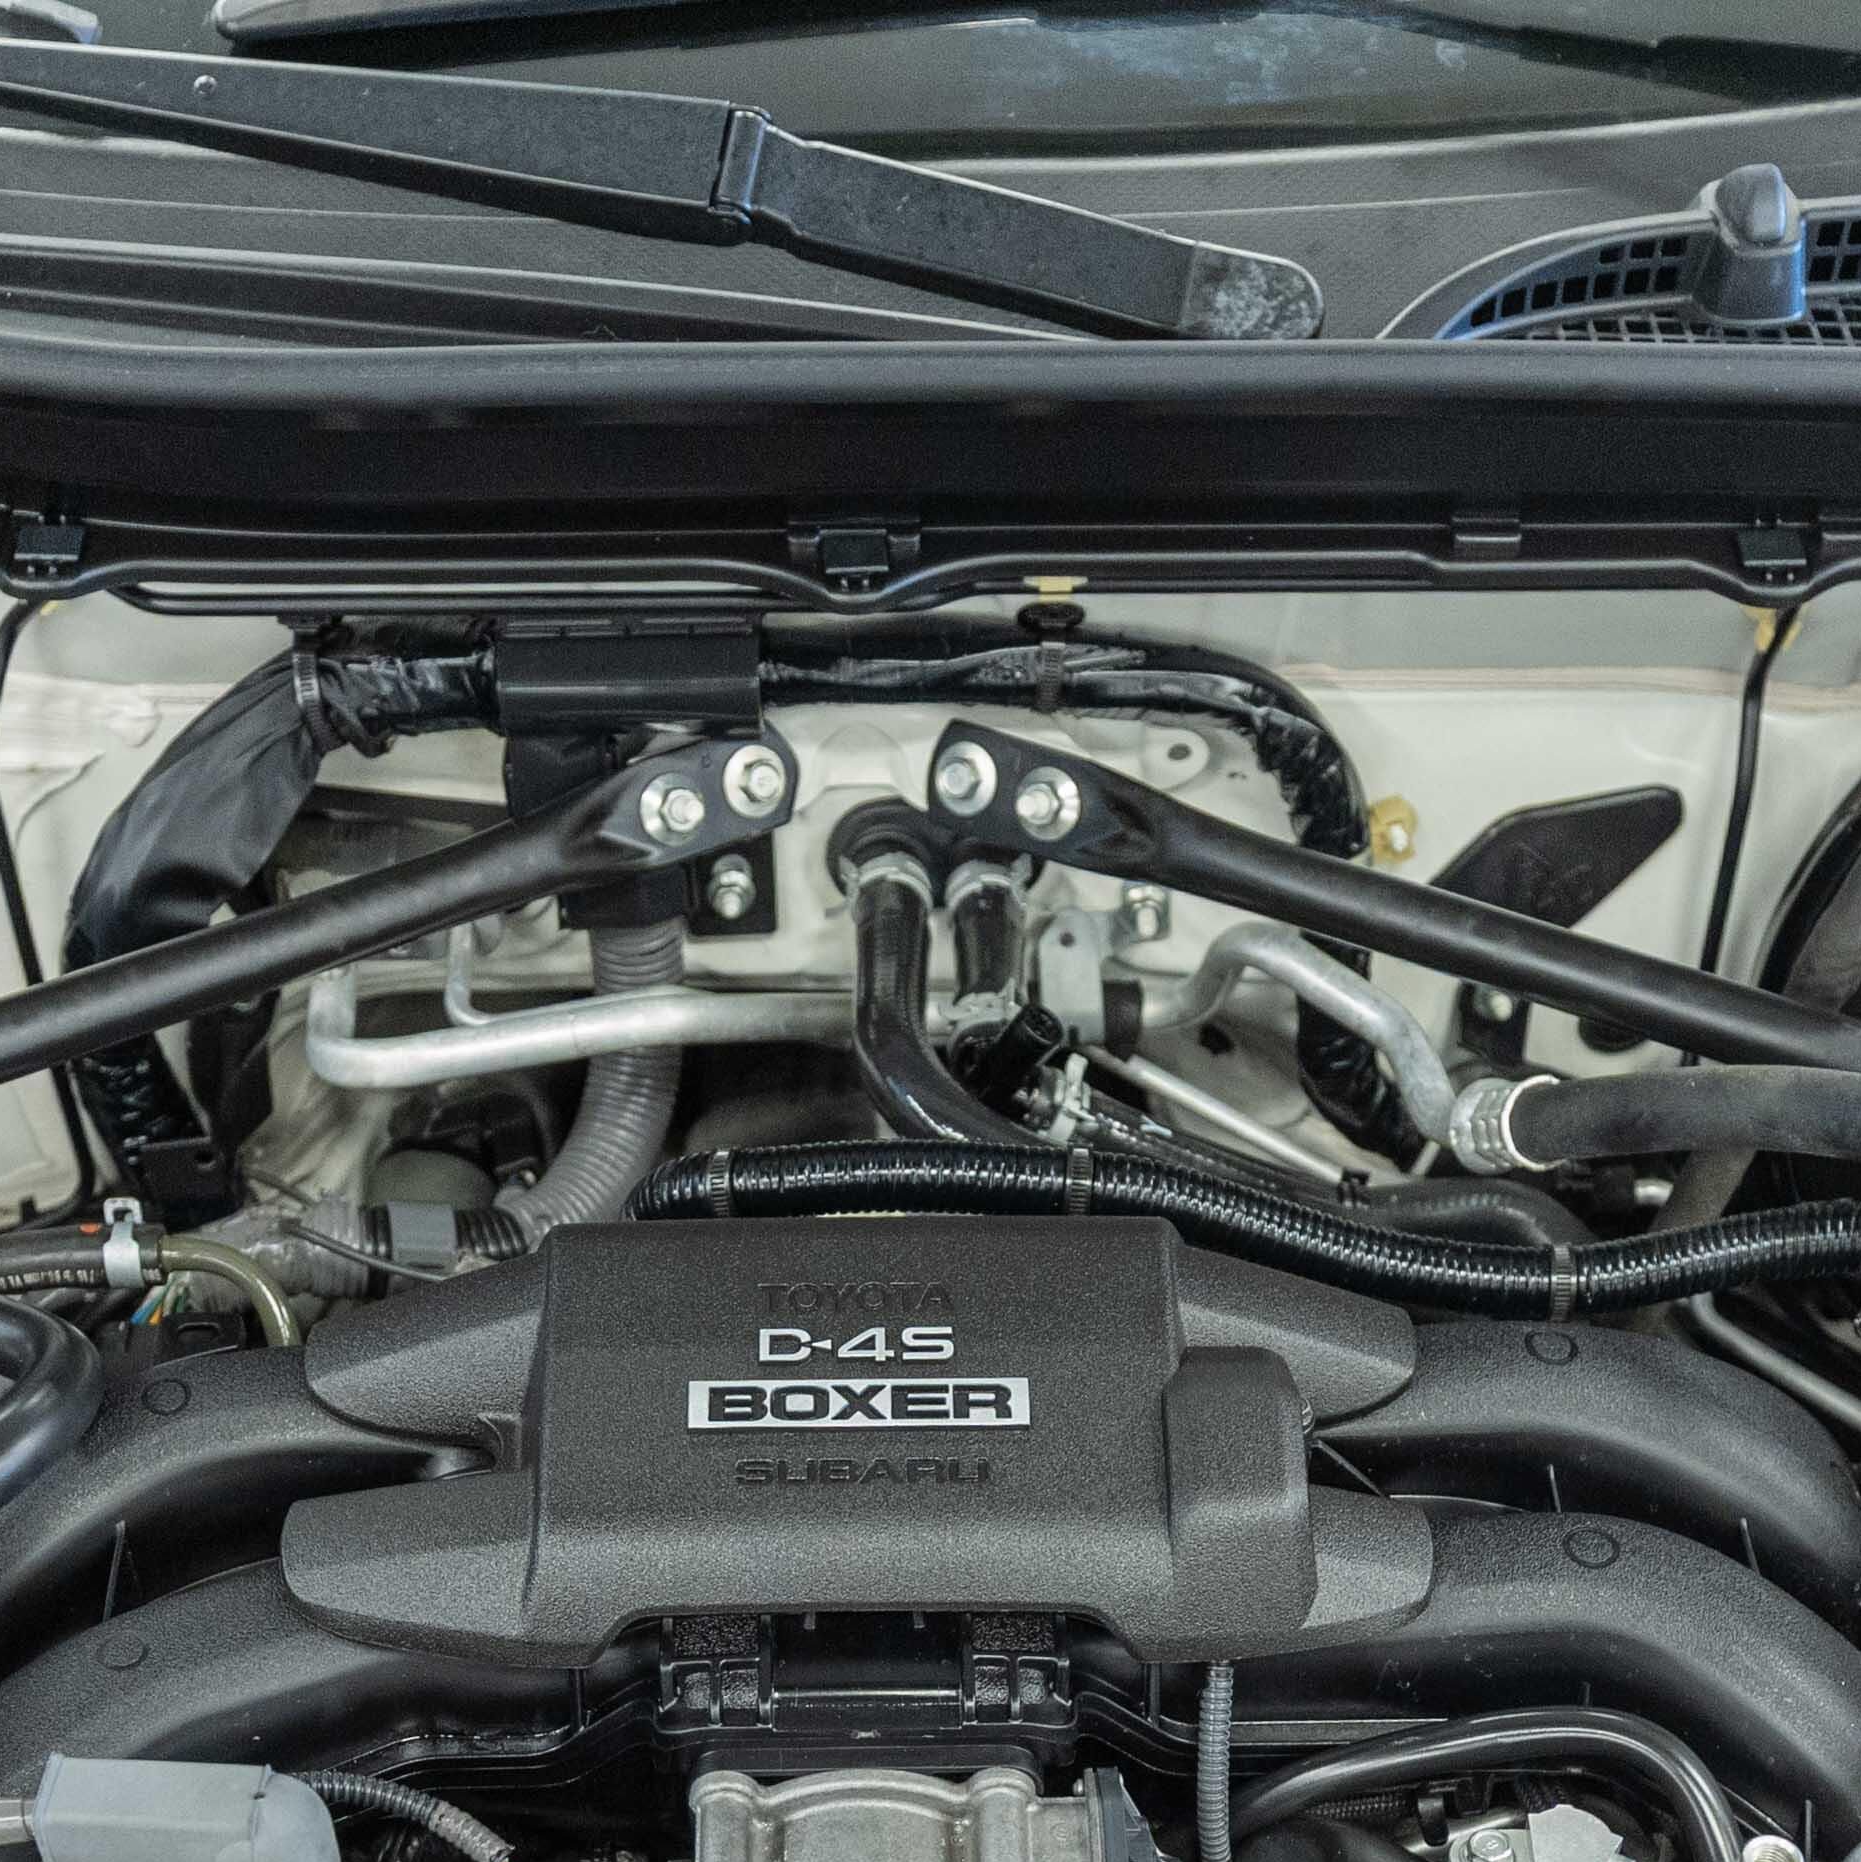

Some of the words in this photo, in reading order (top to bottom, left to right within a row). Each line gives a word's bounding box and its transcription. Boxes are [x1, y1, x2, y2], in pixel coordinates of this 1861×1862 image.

[757, 1280, 953, 1312] TOYOTA
[757, 1326, 956, 1363] D-4S
[707, 1382, 1013, 1422] BOXER
[735, 1456, 990, 1487] SUBARU
